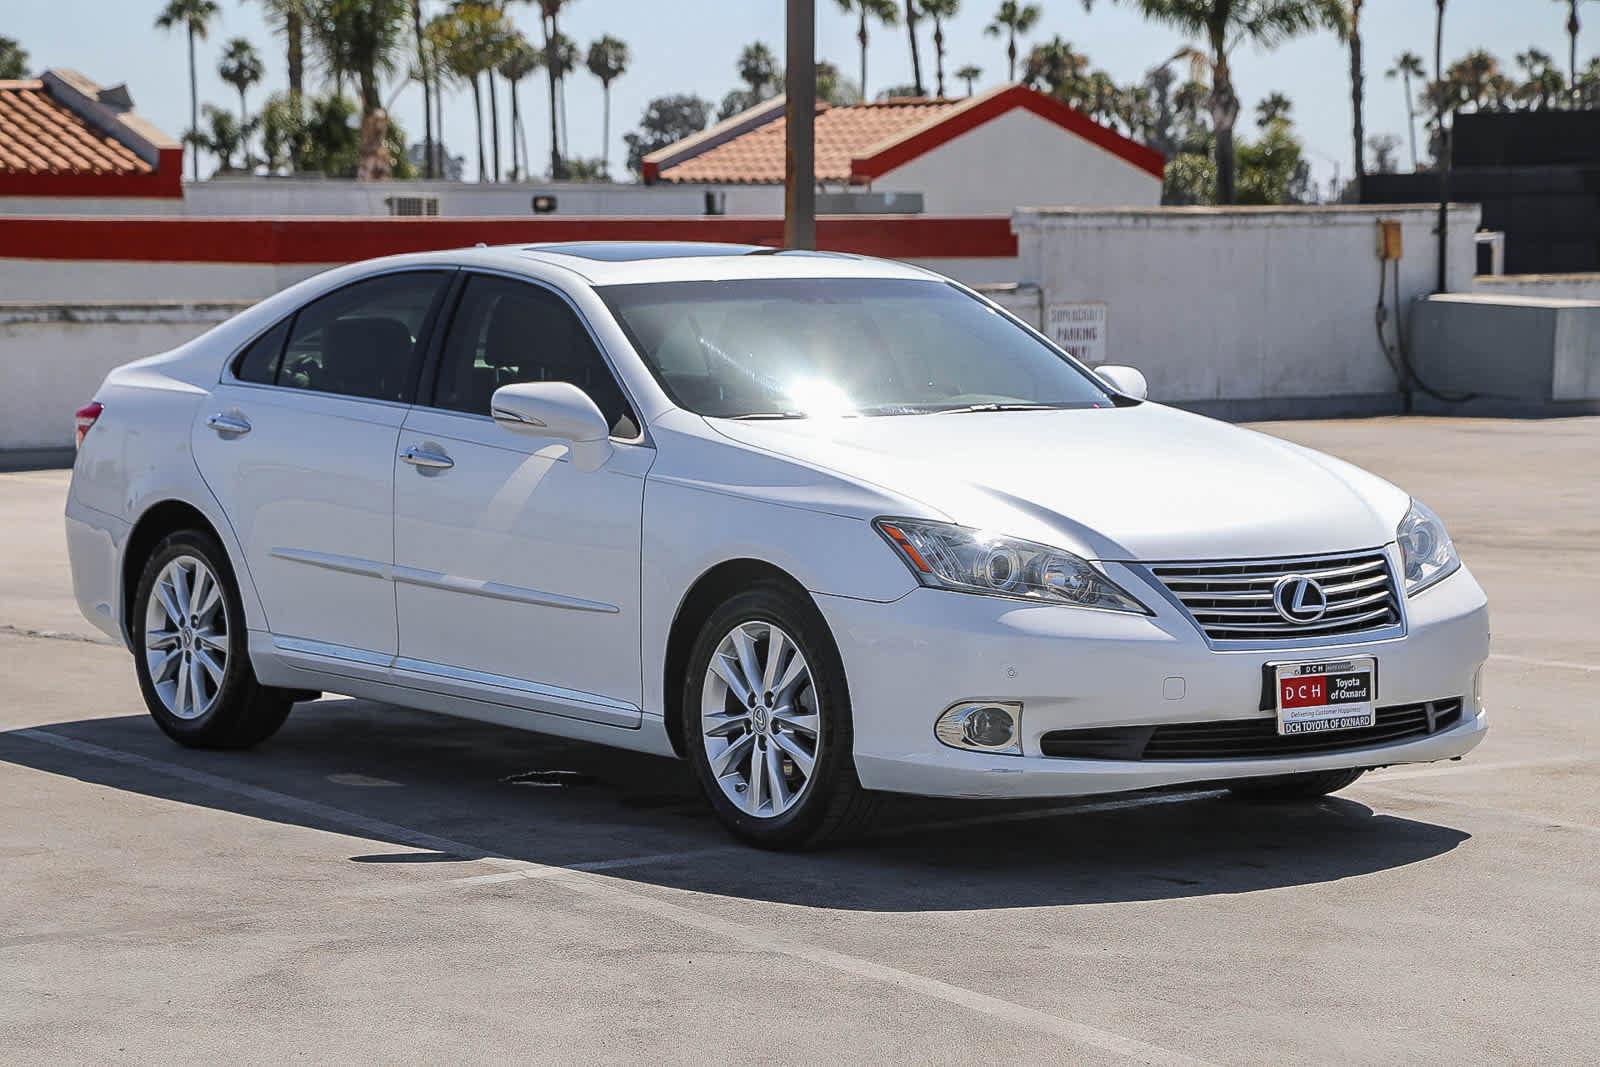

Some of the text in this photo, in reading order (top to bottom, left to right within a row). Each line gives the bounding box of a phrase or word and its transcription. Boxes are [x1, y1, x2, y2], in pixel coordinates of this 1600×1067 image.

[1058, 328, 1097, 341] PARKING
[1336, 678, 1360, 689] Toyota
[1330, 687, 1367, 699] of Oxnard
[1285, 716, 1370, 734] DCH TOYOTA OF OXNARD
